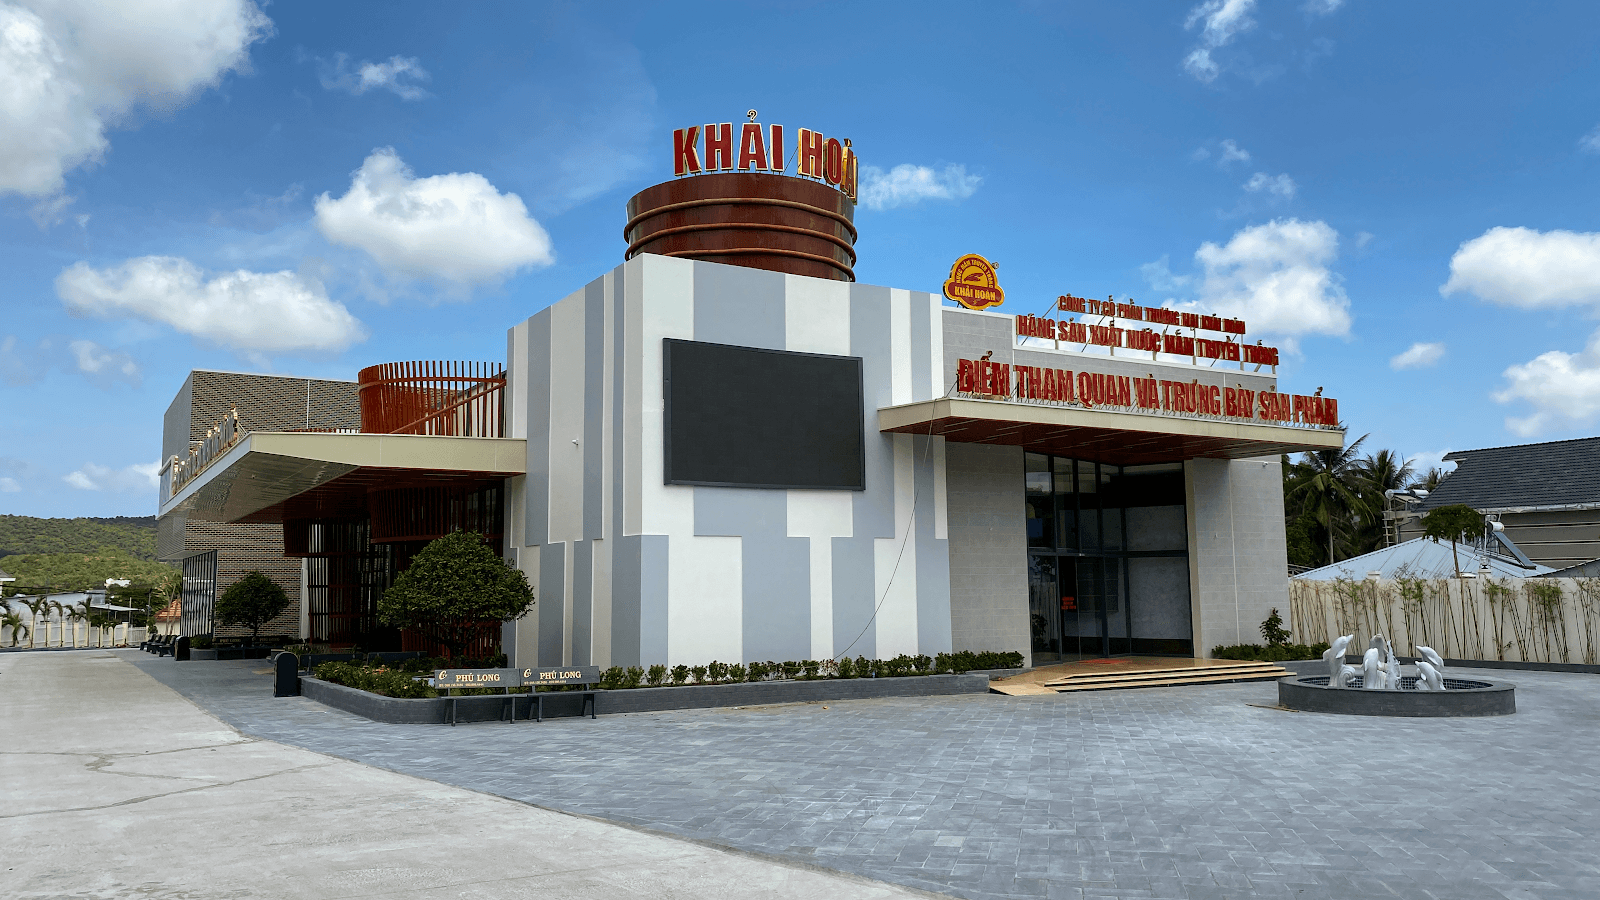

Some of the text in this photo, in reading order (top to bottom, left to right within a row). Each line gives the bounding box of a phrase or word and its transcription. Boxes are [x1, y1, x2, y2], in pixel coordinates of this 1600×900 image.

[673, 109, 858, 205] KHẢI HOÀ
[954, 285, 996, 301] KHẢI HOÀN
[1058, 293, 1086, 313] CÔNG
[1087, 299, 1101, 315] TY
[1101, 295, 1116, 317] CỔ
[1116, 298, 1143, 321] PHẦN
[1016, 313, 1056, 340] HÃNG
[1058, 317, 1087, 344] SẢN
[1089, 320, 1124, 348] XUẤT
[1126, 327, 1162, 353] NƯỚC
[1195, 335, 1241, 362] TRUYỀN
[1242, 339, 1279, 366] THỐNG
[956, 350, 1339, 427] ĐIỂM THAM QUAN VÀ TRƯNG BÀY SẢN PHẨM
[455, 672, 475, 682] PHÚ
[477, 673, 501, 682] LONG
[539, 670, 557, 680] PHÚ
[559, 670, 582, 680] LONG
